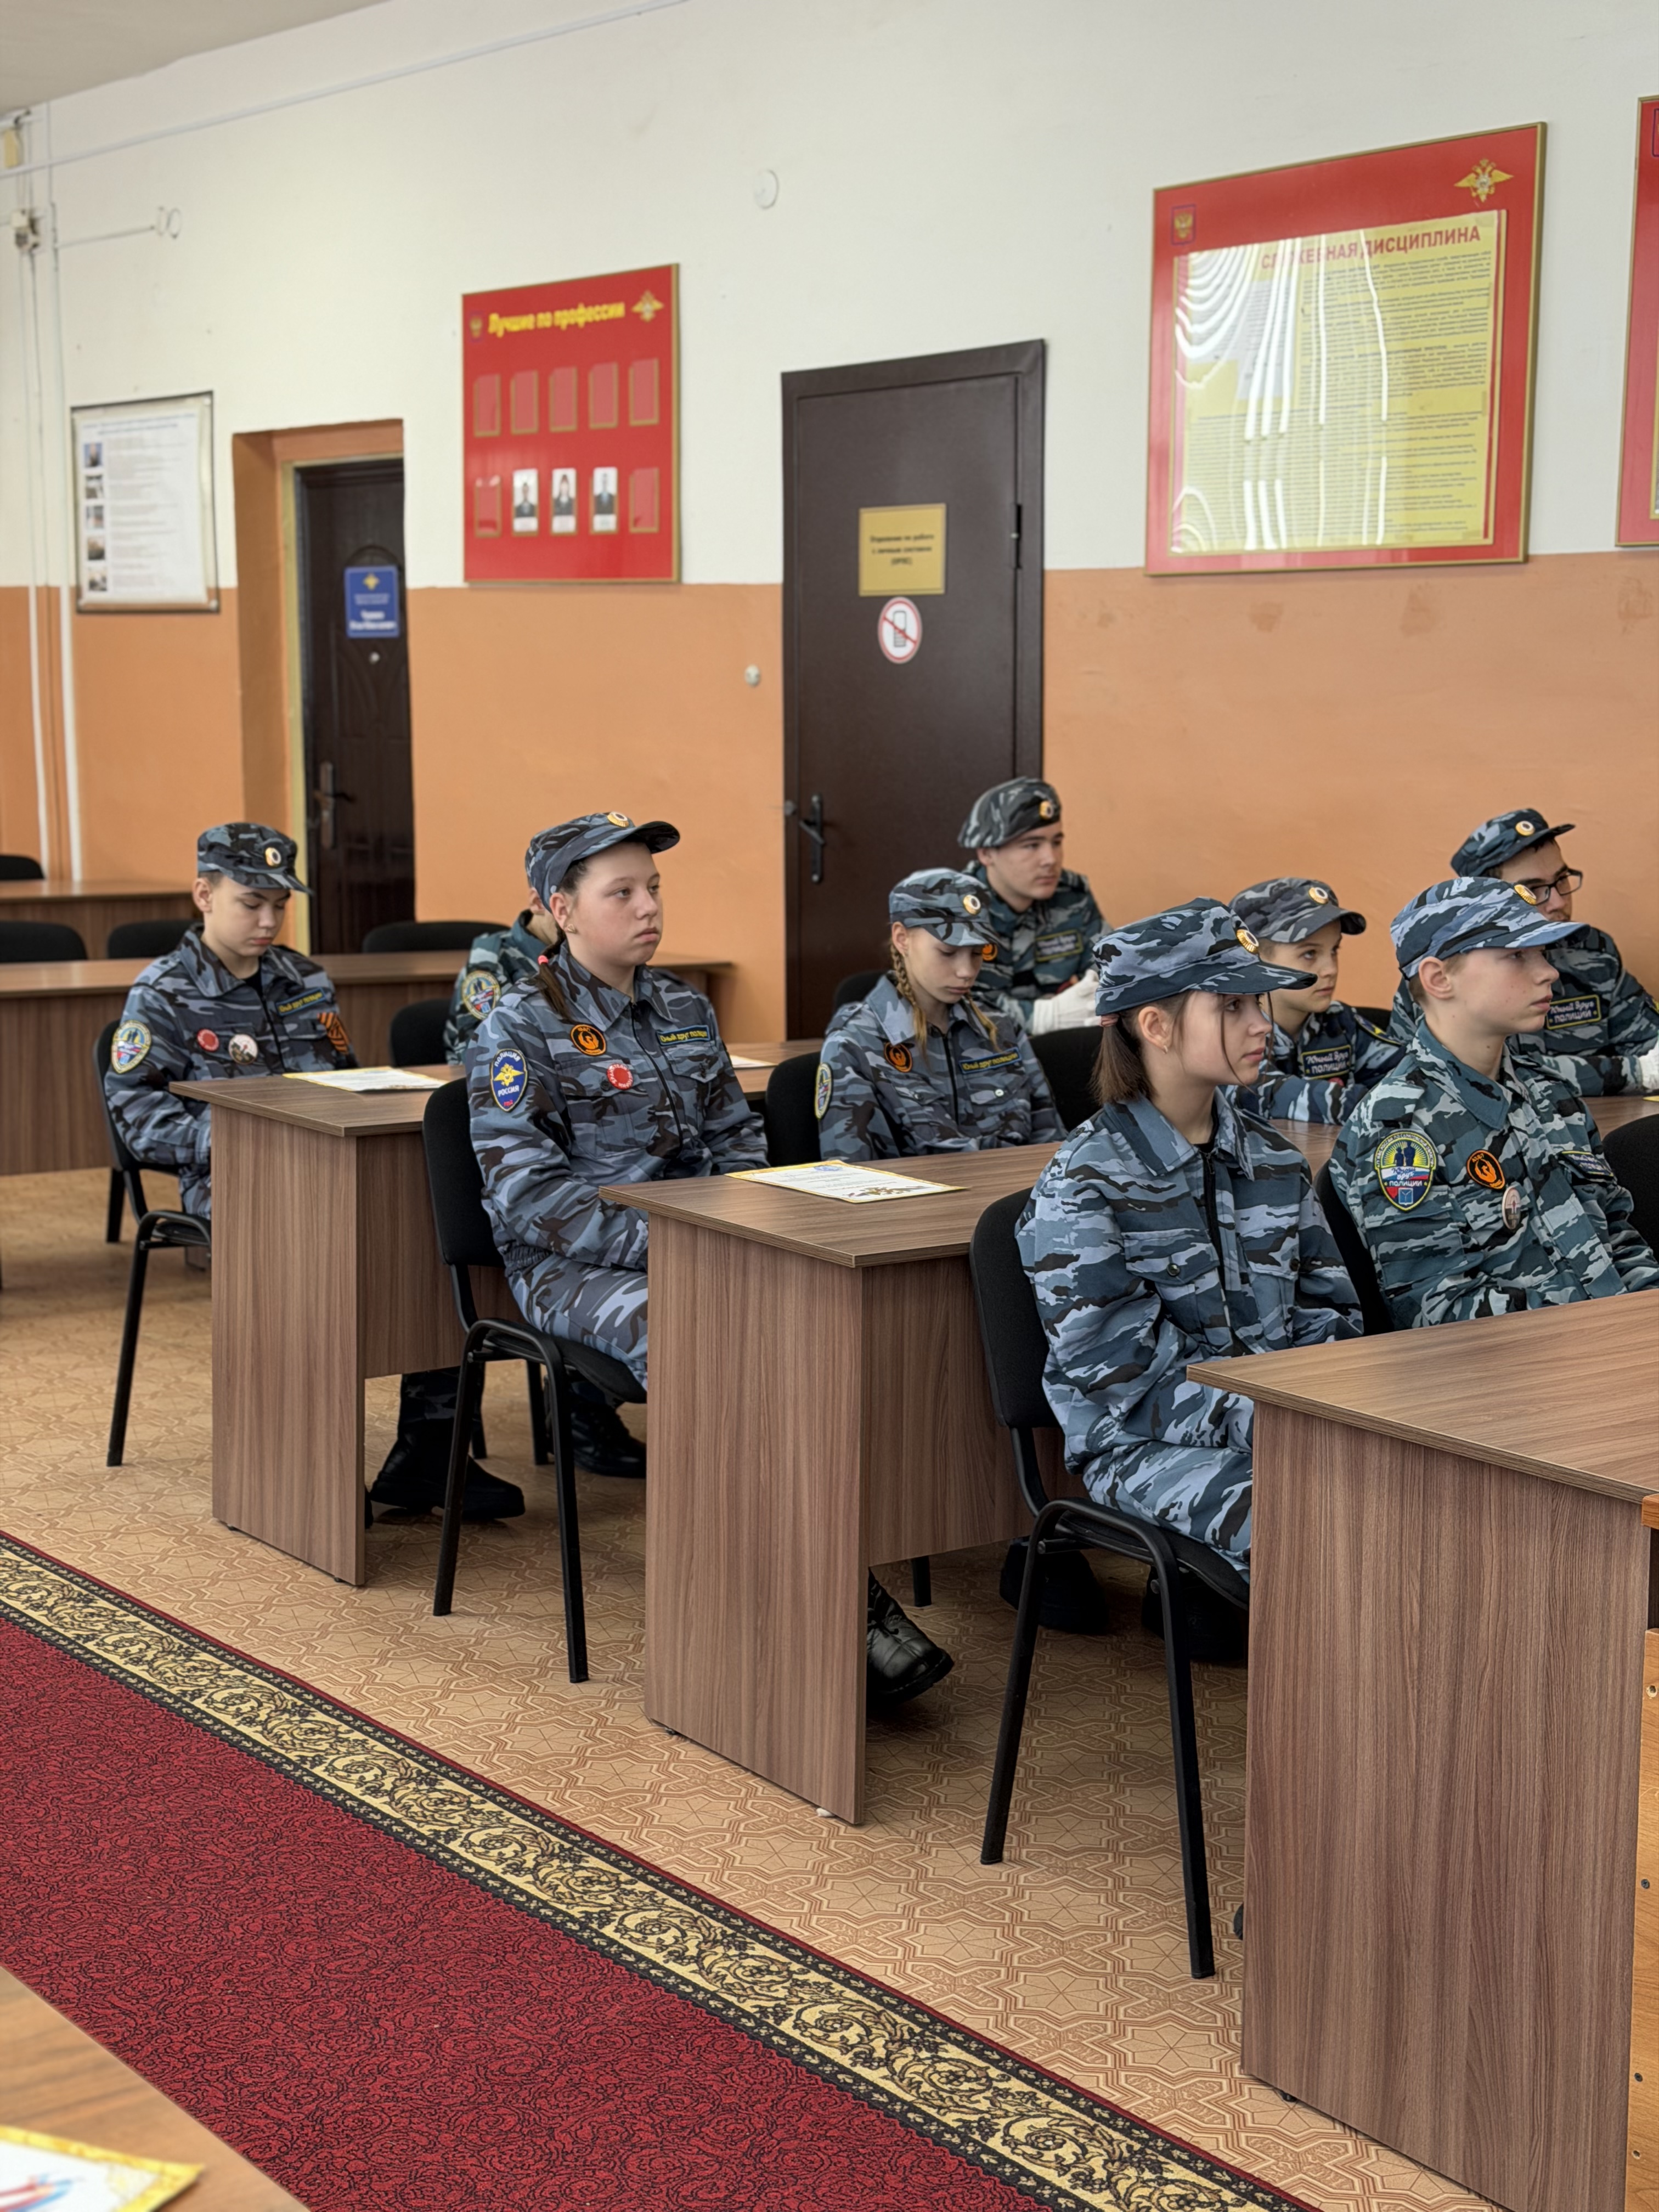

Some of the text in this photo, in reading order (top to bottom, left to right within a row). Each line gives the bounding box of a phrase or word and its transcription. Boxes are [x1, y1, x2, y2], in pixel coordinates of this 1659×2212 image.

[1360, 225, 1481, 259] ДИСЦИПЛИНА
[488, 302, 625, 338] Лучшие по профессии
[498, 1085, 520, 1097] РОССИЯ
